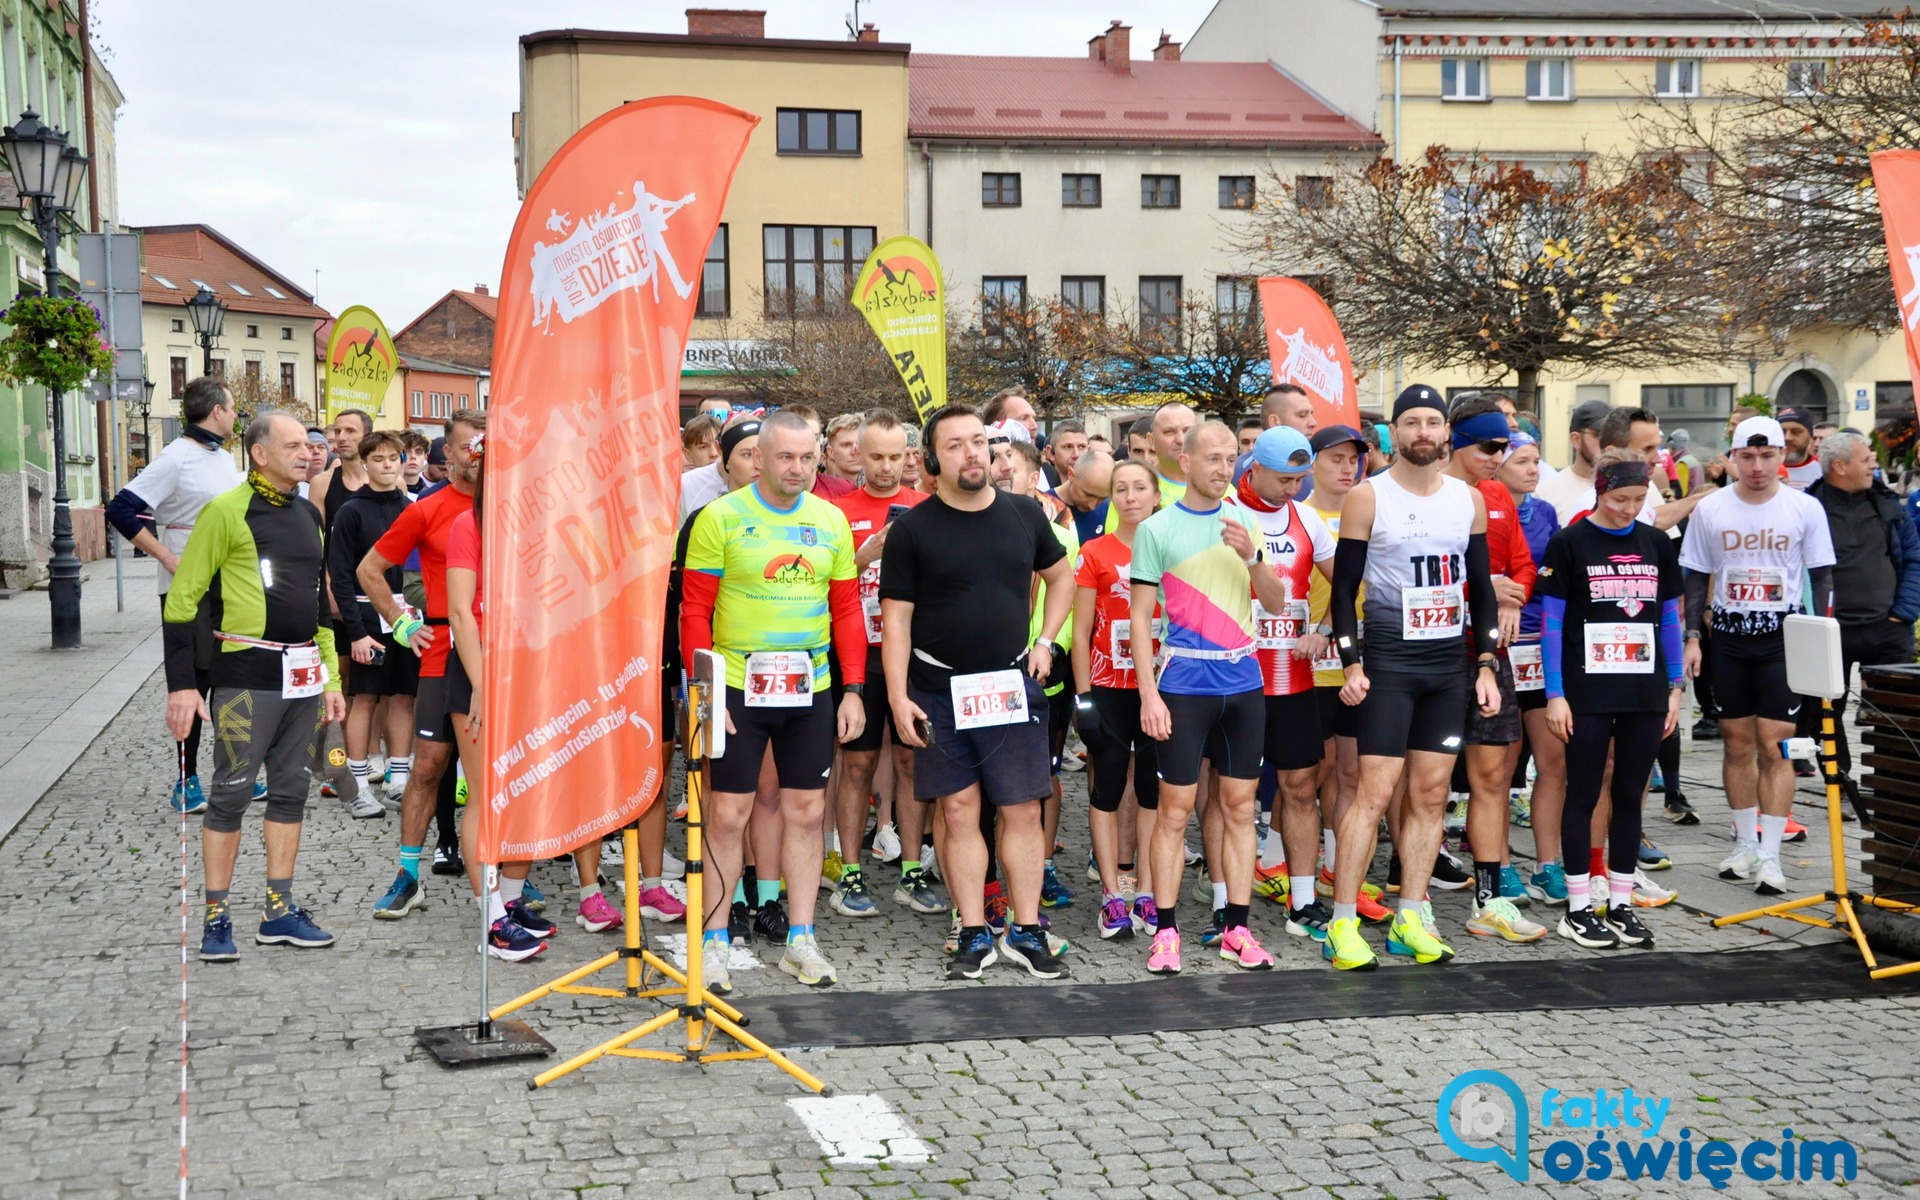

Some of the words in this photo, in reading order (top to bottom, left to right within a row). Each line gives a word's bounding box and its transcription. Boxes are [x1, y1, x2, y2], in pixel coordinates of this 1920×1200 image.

[553, 241, 593, 275] MIASTO
[592, 212, 642, 253] OŚWIĘCIM
[577, 232, 651, 299] DZIEJE!
[686, 349, 723, 363] BNP
[332, 356, 388, 387] zadyszka
[496, 458, 586, 538] MIASTO
[1721, 528, 1790, 552] Delia
[764, 571, 816, 589] zadyszka
[1586, 565, 1615, 577] UNIA
[1588, 579, 1659, 599] SWIMMIN
[1733, 585, 1765, 601] 170
[1416, 609, 1448, 627] 122
[1264, 620, 1295, 638] 189
[1603, 644, 1627, 662] 84
[306, 668, 316, 685] 5
[762, 675, 787, 694] 75
[966, 694, 1002, 715] 108
[526, 698, 593, 752] Oświęcim
[597, 684, 616, 703] tu
[490, 789, 511, 816] FB/
[500, 835, 563, 857] Promujemy
[562, 808, 621, 844] wydarzenia
[627, 766, 659, 811] Oświęcimiu
